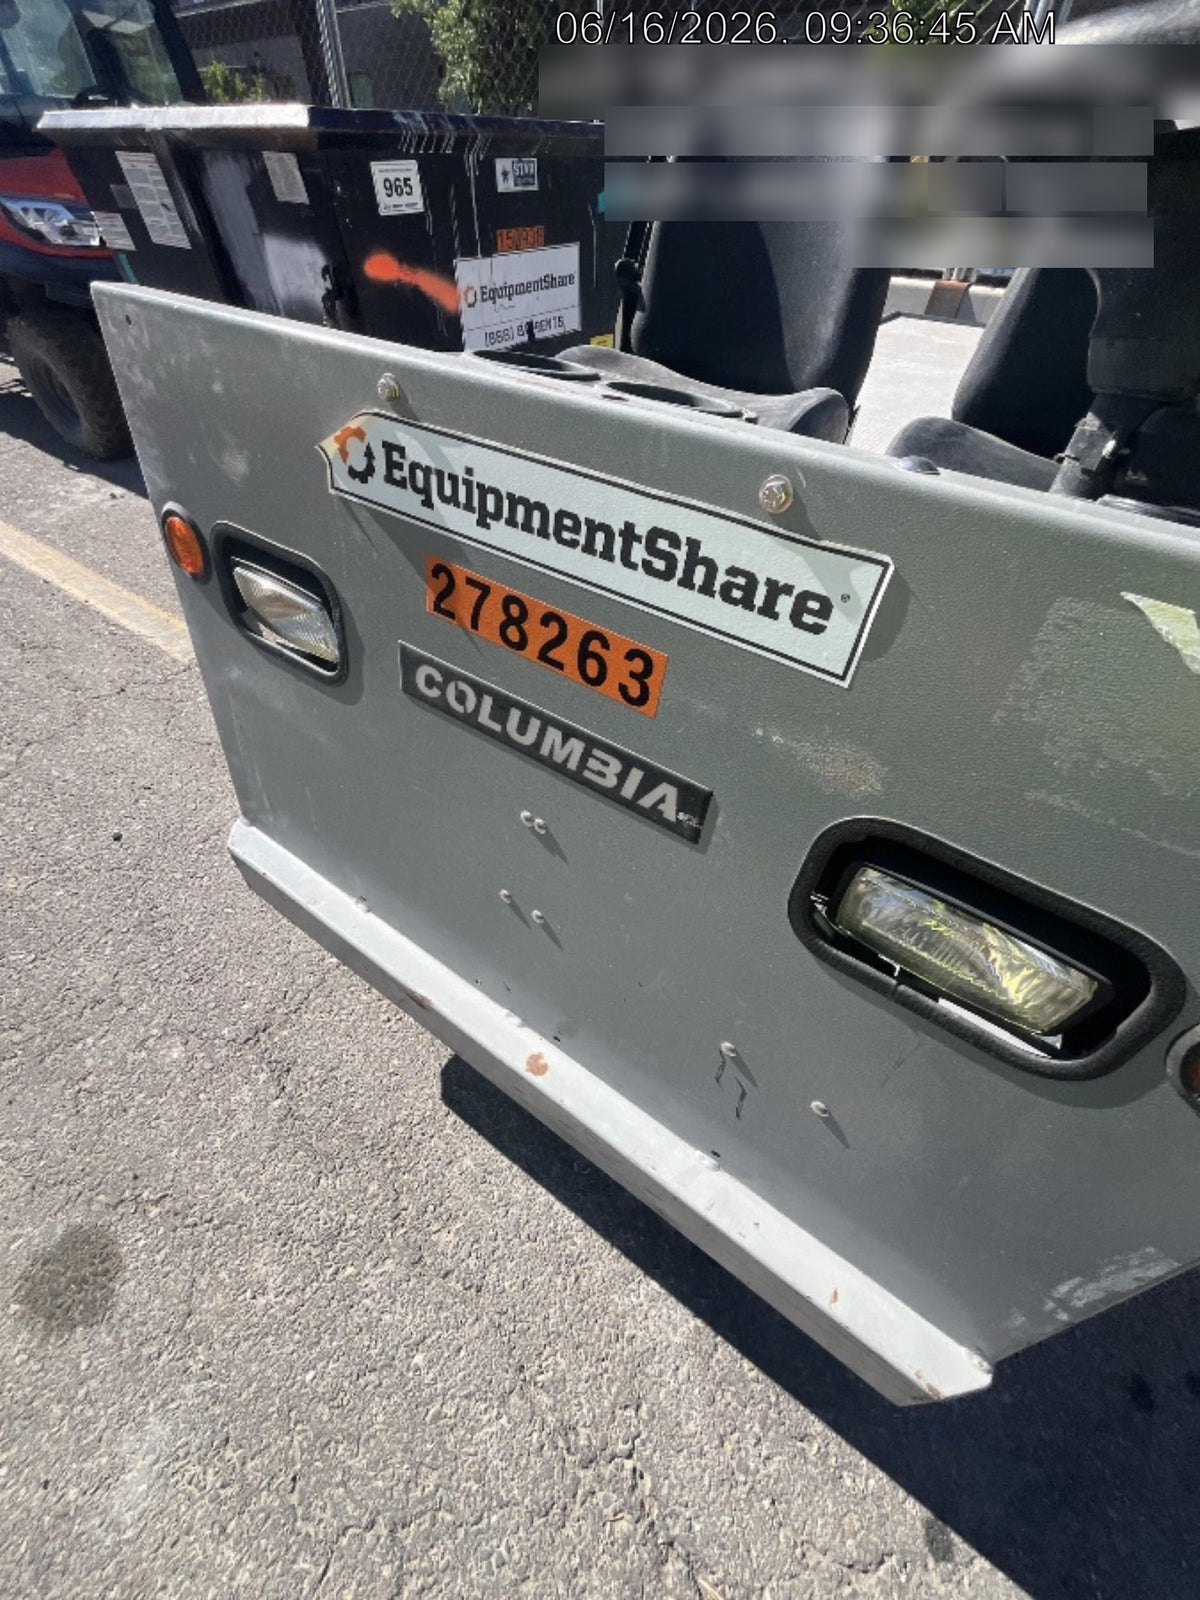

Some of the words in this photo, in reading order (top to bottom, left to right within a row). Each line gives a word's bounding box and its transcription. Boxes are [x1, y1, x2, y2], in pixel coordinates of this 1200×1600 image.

[383, 177, 413, 198] 965
[480, 273, 575, 304] EquipmentShare
[381, 440, 833, 635] EquipmentShare
[431, 562, 655, 708] 278263
[414, 664, 678, 823] COLUMBIA
